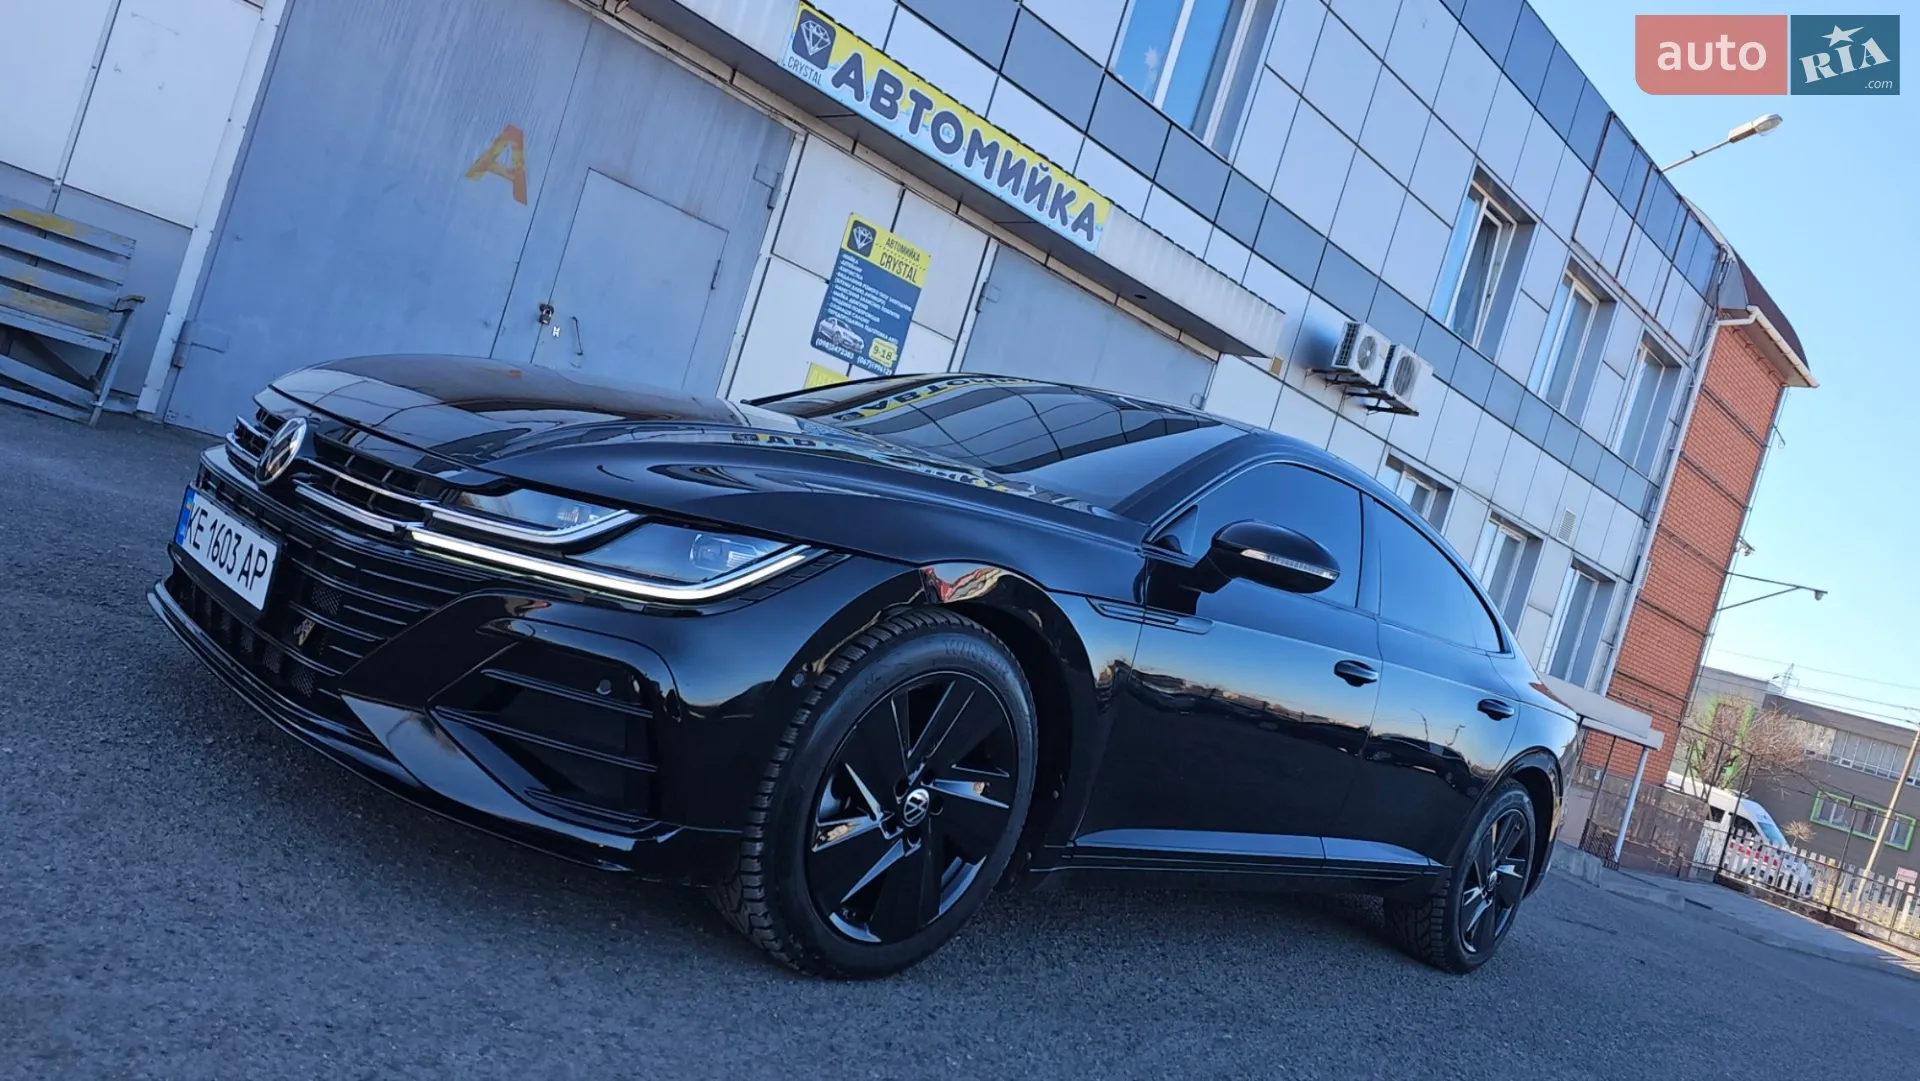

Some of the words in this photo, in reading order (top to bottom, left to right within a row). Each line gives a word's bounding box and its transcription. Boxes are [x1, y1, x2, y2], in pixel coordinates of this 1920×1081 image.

[787, 56, 823, 86] CRYSTAL
[831, 52, 1097, 242] АВТОМИЙКА
[885, 237, 921, 262] АВТОМИЙКА
[880, 252, 917, 283] CRYSTAL
[873, 345, 893, 361] 9-18
[185, 504, 208, 550] KE
[207, 519, 242, 575] 1603
[237, 543, 268, 591] AP
